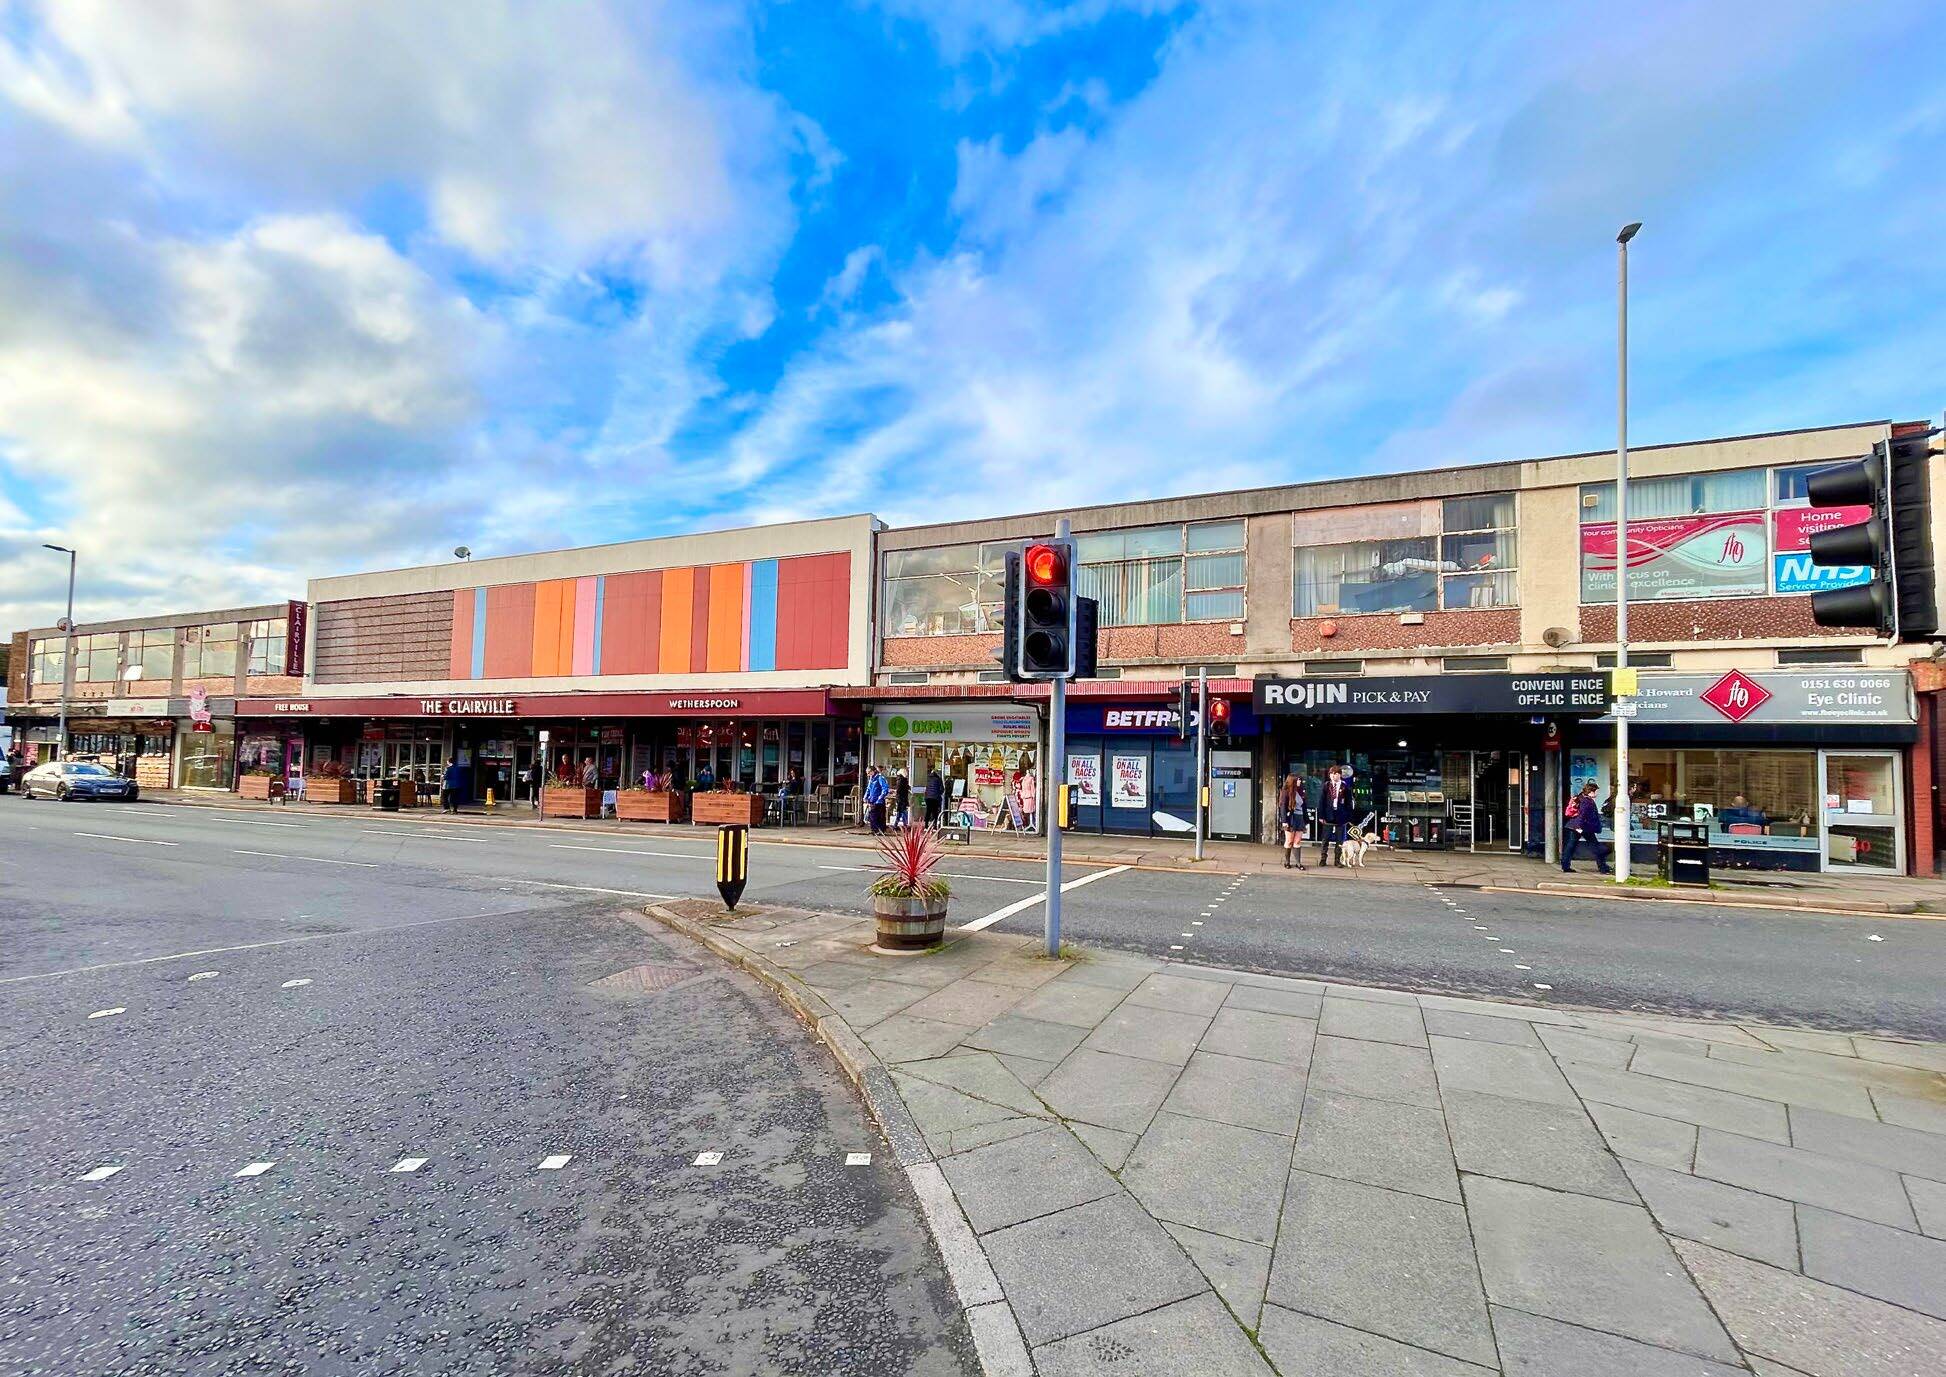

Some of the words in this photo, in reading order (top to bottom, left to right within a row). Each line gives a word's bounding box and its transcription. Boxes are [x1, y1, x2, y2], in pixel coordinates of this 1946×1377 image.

[1801, 512, 1842, 521] Home
[1601, 526, 1644, 536] comunity
[1646, 524, 1684, 533] Opticians
[1588, 572, 1614, 581] With
[1653, 570, 1669, 578] on
[1630, 578, 1695, 588] excellence
[1780, 582, 1816, 591] Service
[293, 607, 302, 670] CLAIRVILLE
[1801, 679, 1830, 689] 0151
[1833, 679, 1855, 688] 630
[1860, 679, 1891, 688] 0066
[1353, 691, 1388, 703] PICK
[1389, 691, 1402, 703] &
[1404, 690, 1431, 703] PAY
[1646, 688, 1694, 697] Howard
[669, 699, 738, 709] WETHERSPOON
[1808, 693, 1833, 706] Eye
[1837, 693, 1882, 705] Clinic
[275, 703, 289, 711] FREE
[420, 700, 442, 714] THE
[449, 700, 513, 714] CLAIRVILLE
[912, 719, 953, 734] OXFAM
[1071, 759, 1080, 768] ON
[1081, 760, 1093, 768] ALL
[1116, 761, 1126, 770] ON
[1126, 761, 1140, 769] ALL
[1075, 768, 1097, 777] RACES
[1120, 770, 1143, 779] RACES
